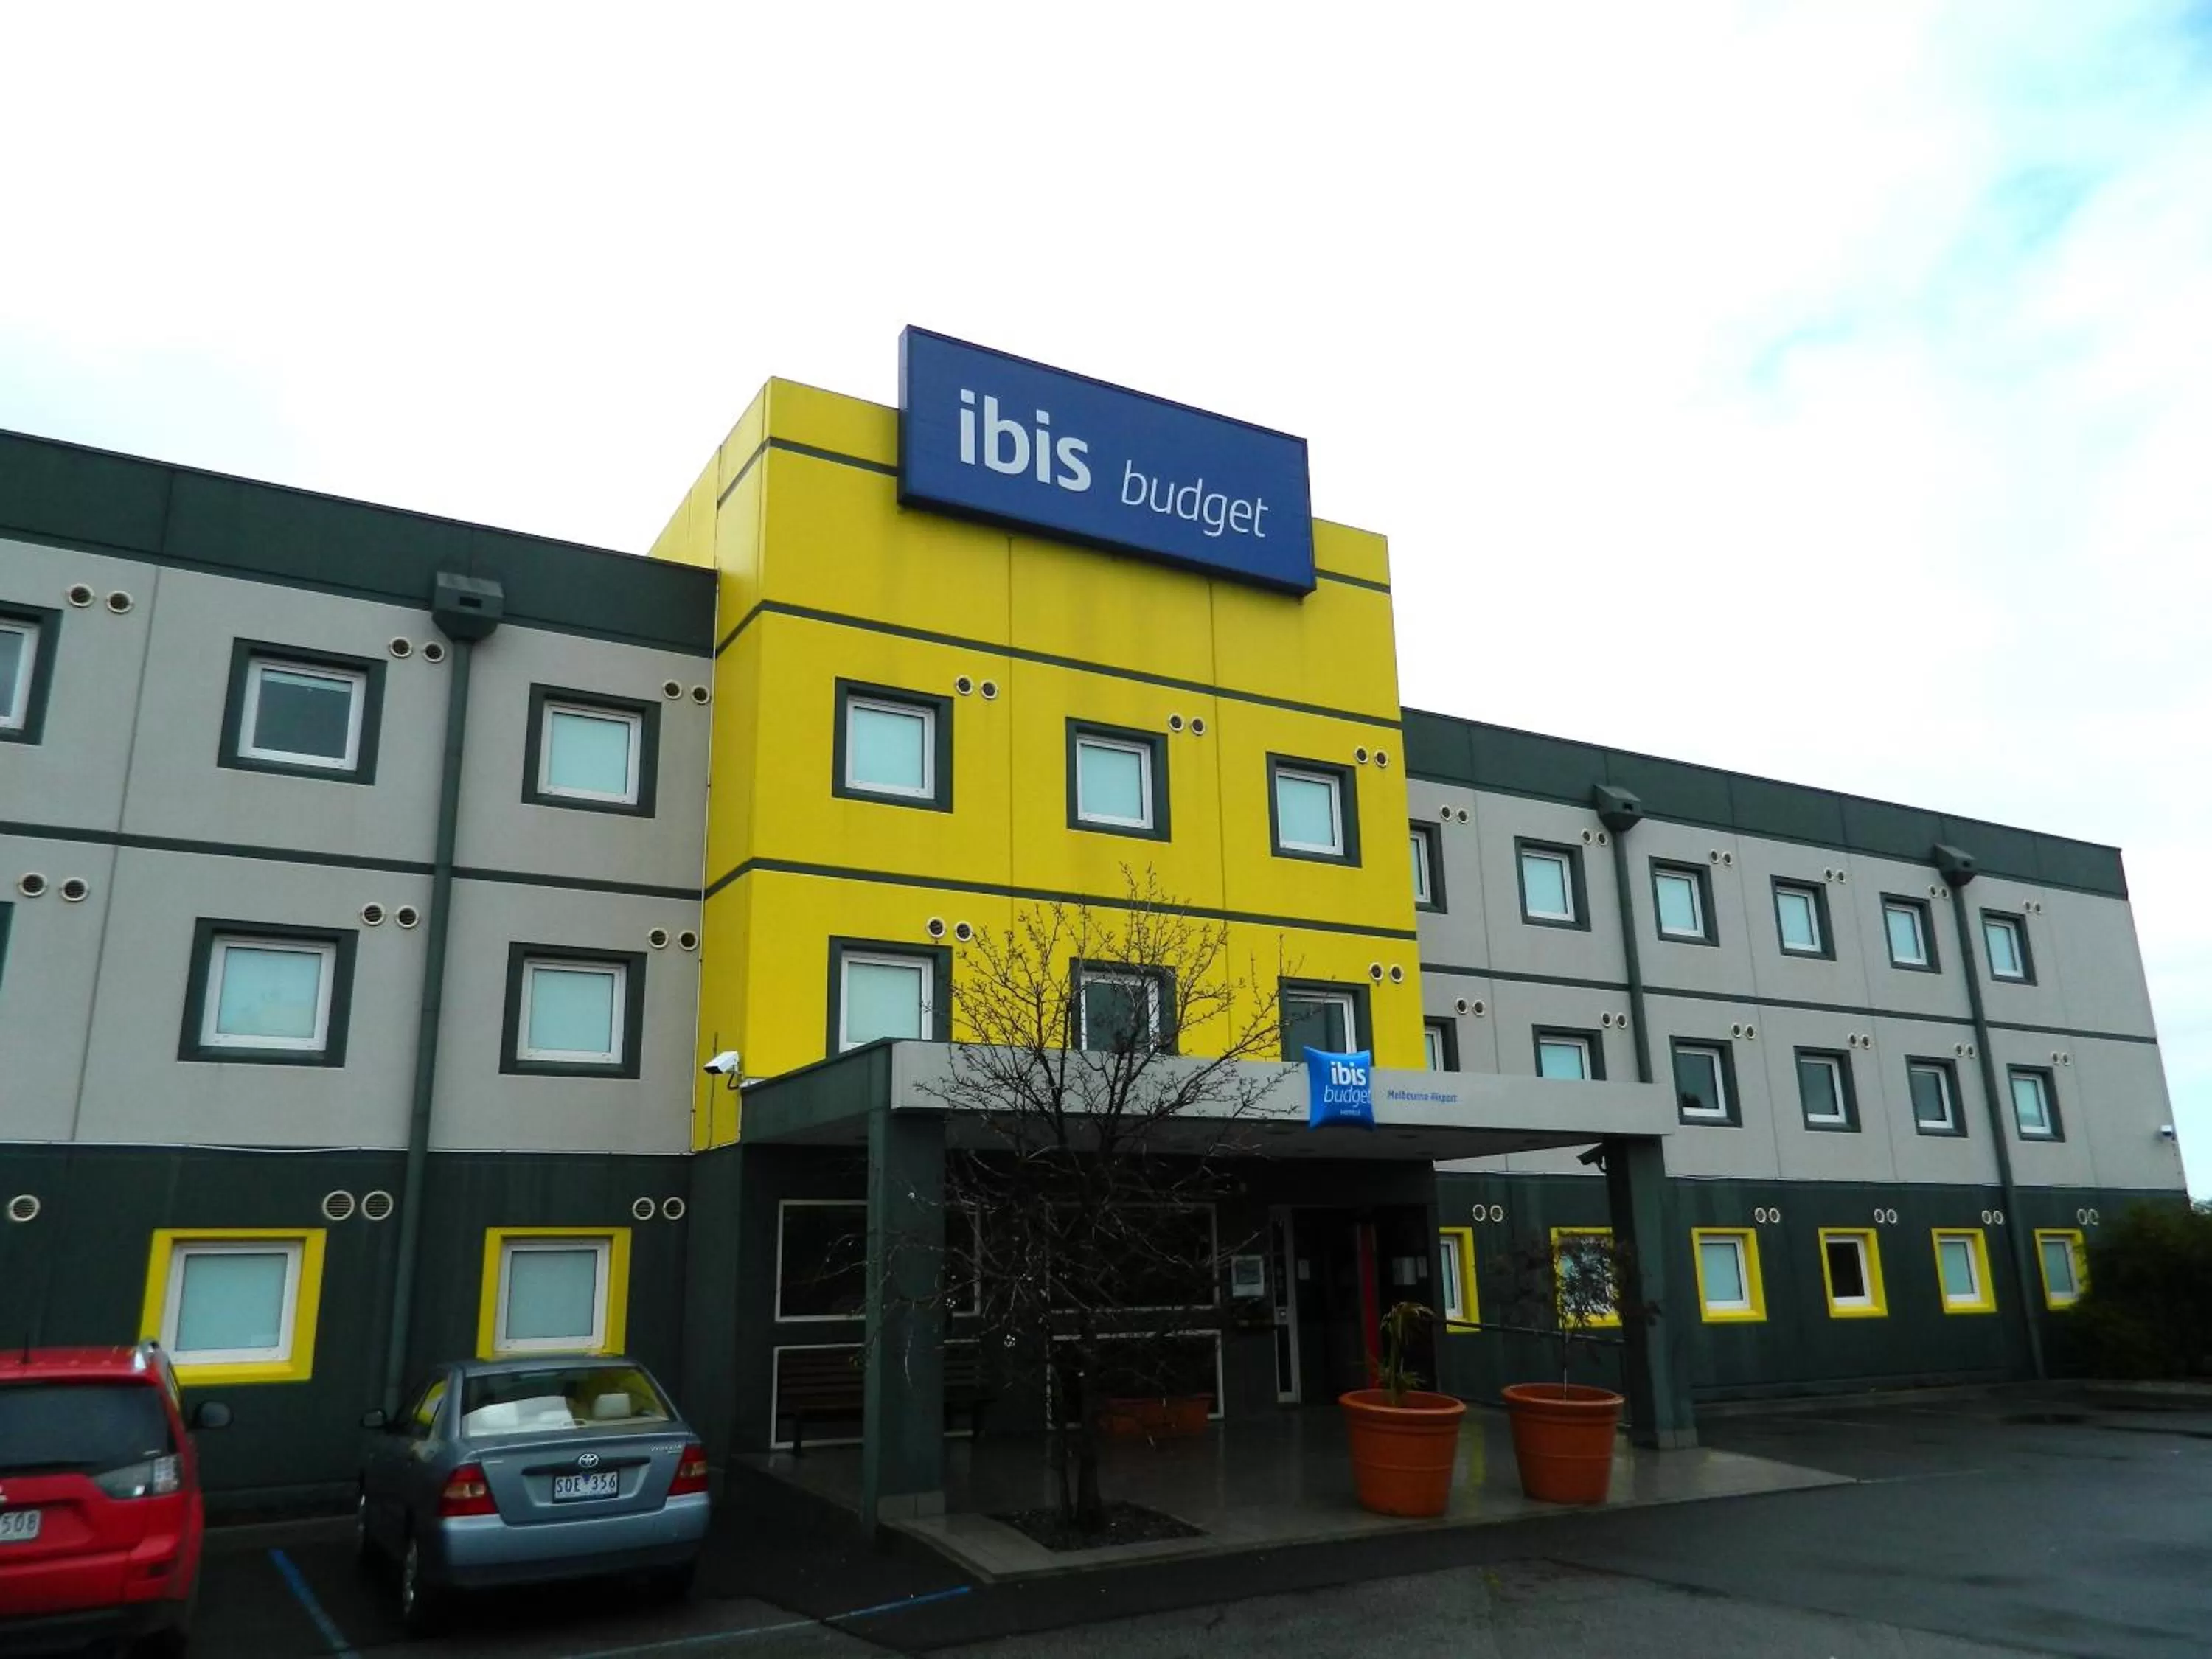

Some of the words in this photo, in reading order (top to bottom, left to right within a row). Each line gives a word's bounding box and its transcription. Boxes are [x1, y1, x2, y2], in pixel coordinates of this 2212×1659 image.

[960, 388, 1092, 493] ibis
[1121, 459, 1269, 538] budget
[1330, 1060, 1366, 1086] ibis
[1387, 1089, 1429, 1101] Melbourne
[1430, 1092, 1458, 1103] Airport
[592, 1474, 616, 1490] 356
[1, 1513, 37, 1534] 508
